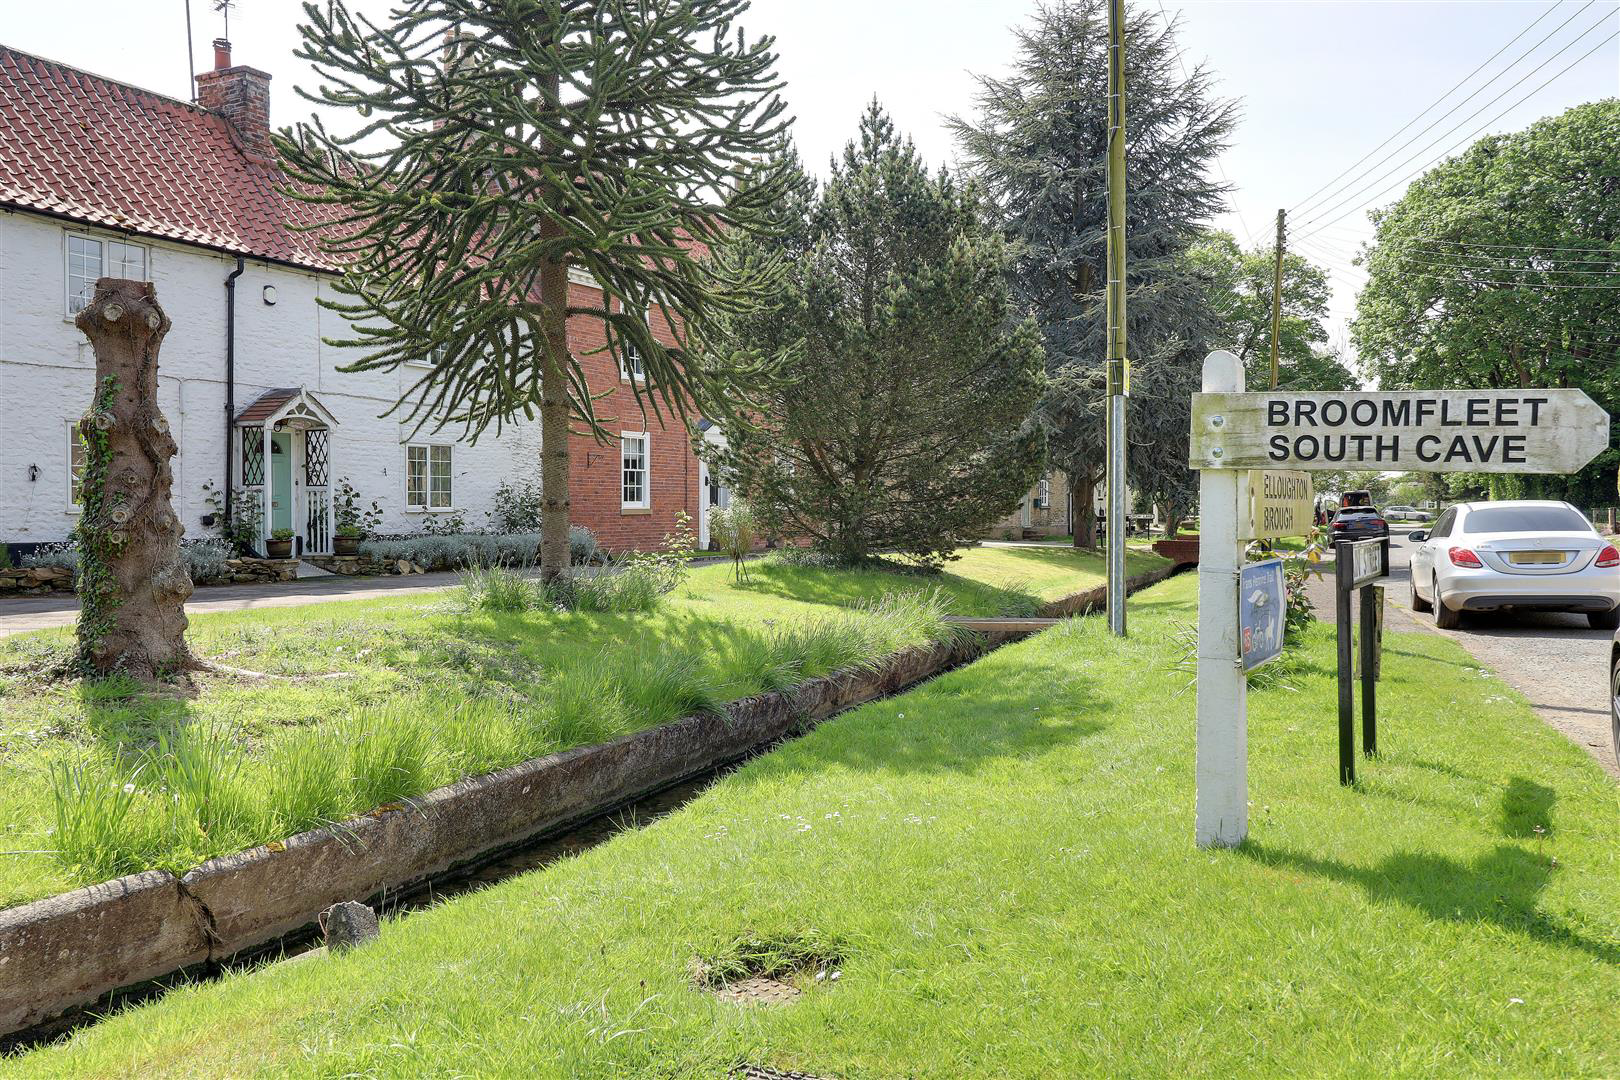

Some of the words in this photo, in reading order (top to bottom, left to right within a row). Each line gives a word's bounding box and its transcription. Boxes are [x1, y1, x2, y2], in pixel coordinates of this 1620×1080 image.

[1267, 398, 1548, 427] BROOMFLEET
[1268, 434, 1399, 463] SOUTH
[1415, 434, 1527, 463] CAVE
[1264, 474, 1308, 500] ELLOUGHTON
[1264, 506, 1294, 530] BROUGH
